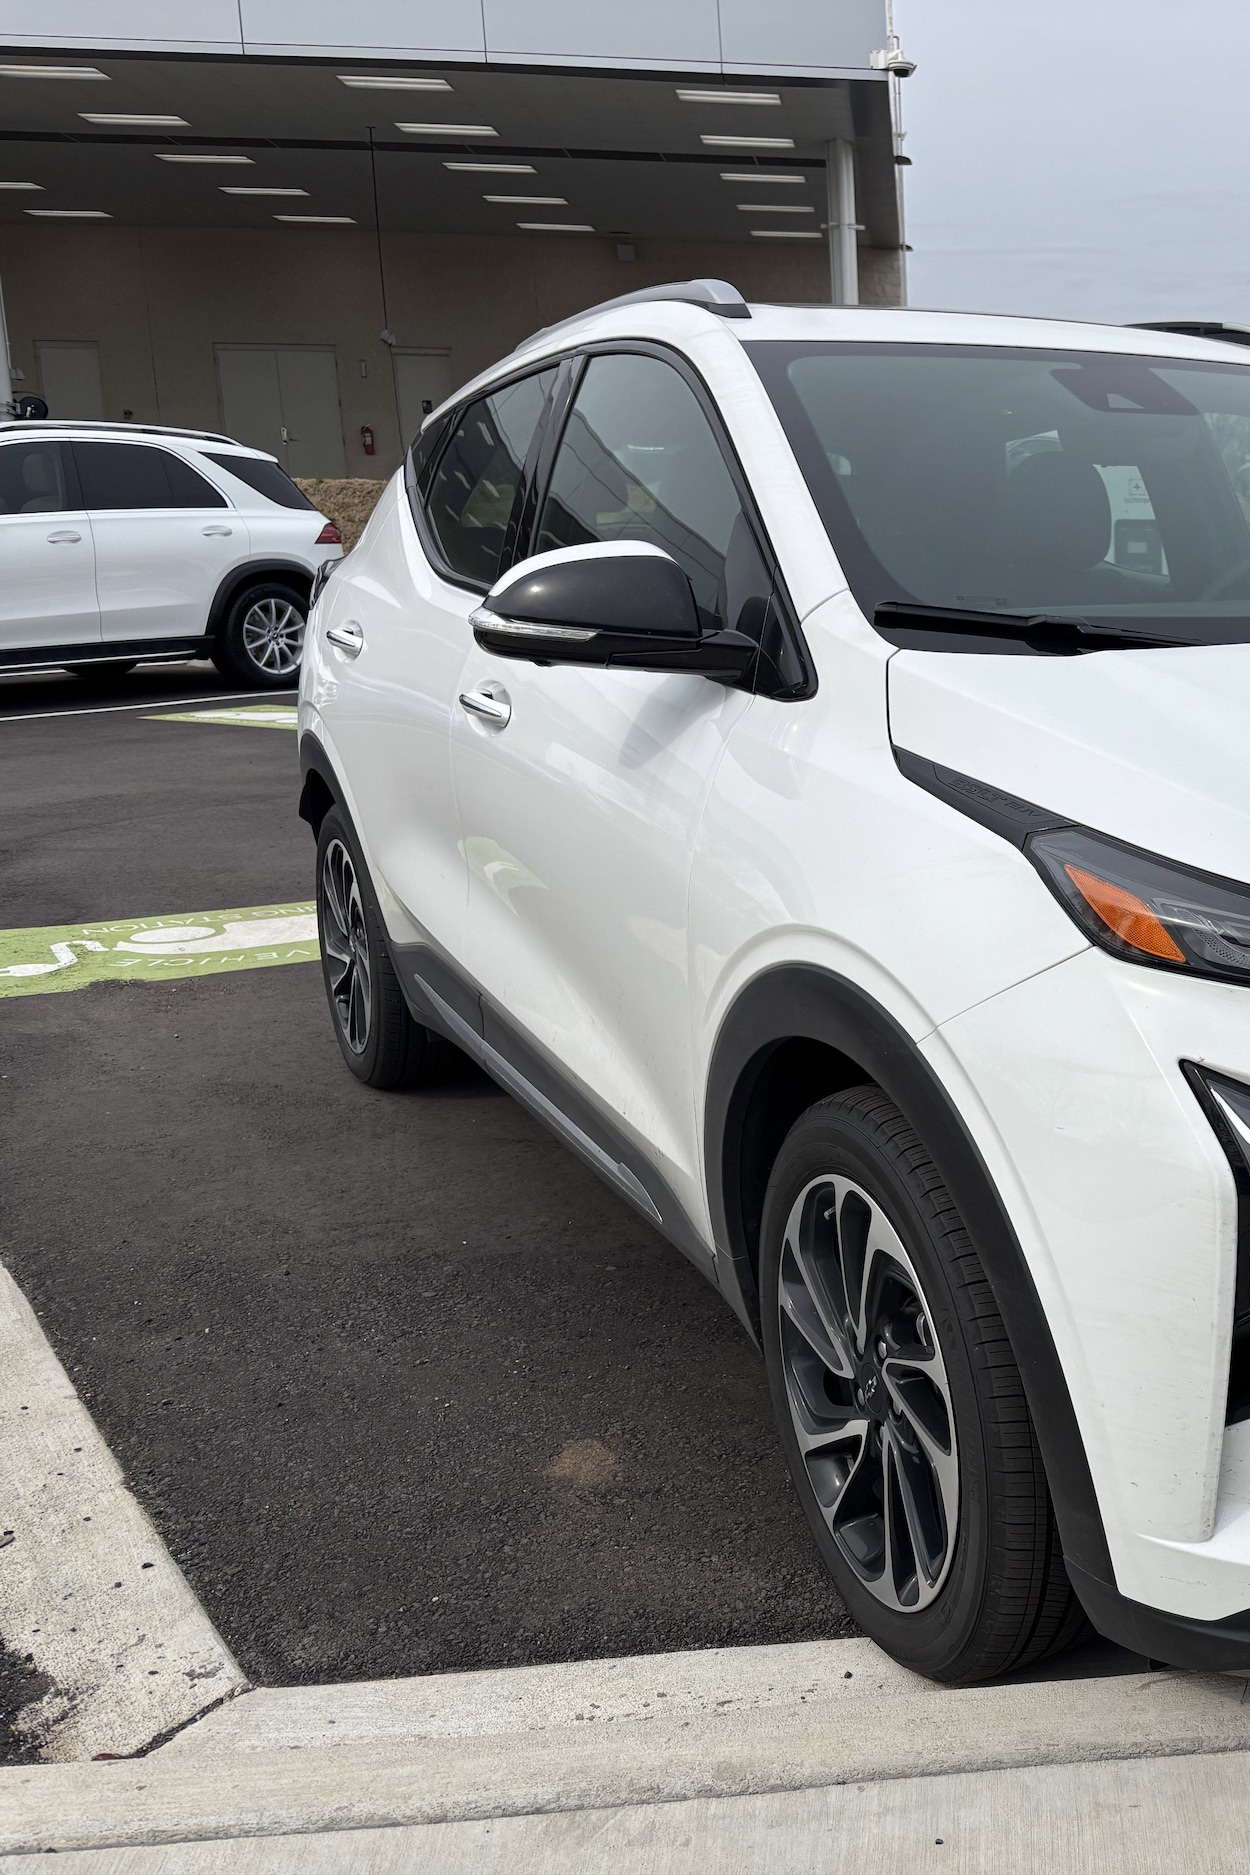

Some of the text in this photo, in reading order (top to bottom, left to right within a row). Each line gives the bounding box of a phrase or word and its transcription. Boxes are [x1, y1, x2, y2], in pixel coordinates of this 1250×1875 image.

[948, 779, 1042, 816] BOLT EUV
[82, 914, 242, 935] STATION
[109, 949, 311, 967] VEHICLE
